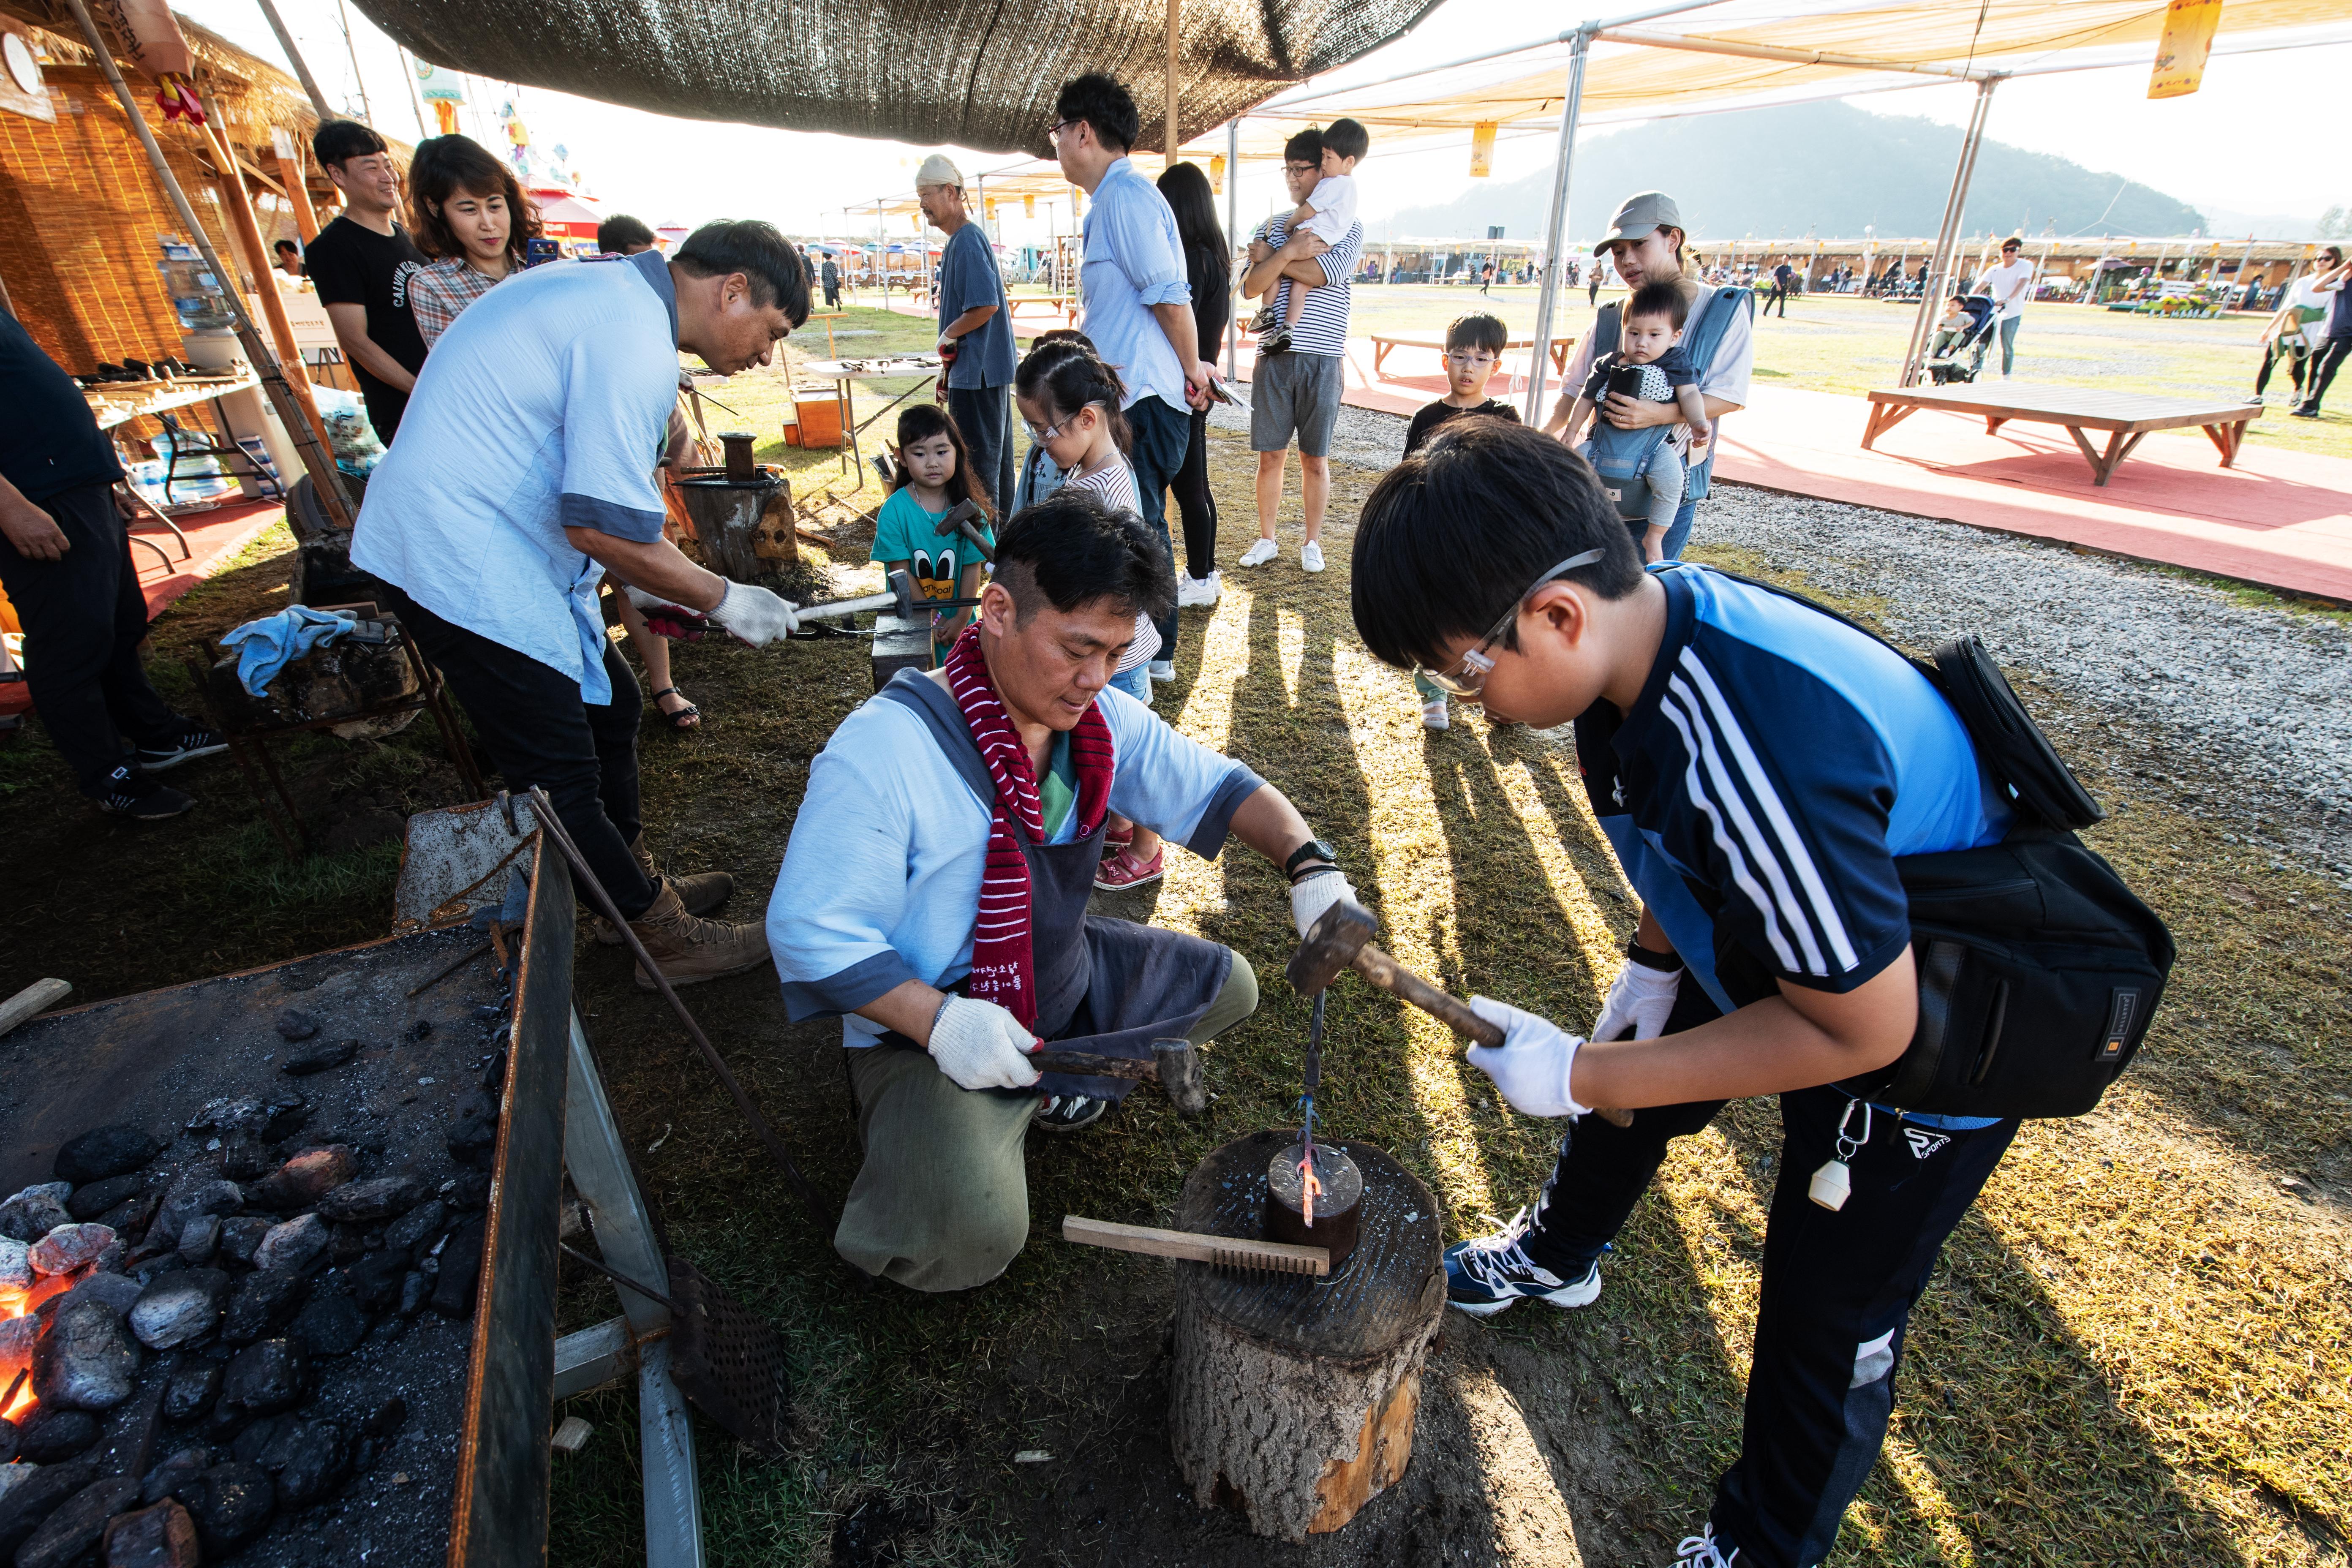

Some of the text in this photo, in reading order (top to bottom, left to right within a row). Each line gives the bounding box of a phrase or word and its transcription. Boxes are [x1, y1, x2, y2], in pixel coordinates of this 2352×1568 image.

[393, 261, 422, 308] CALVIN KLEIN
[1921, 1136, 1951, 1159] SPORTS
